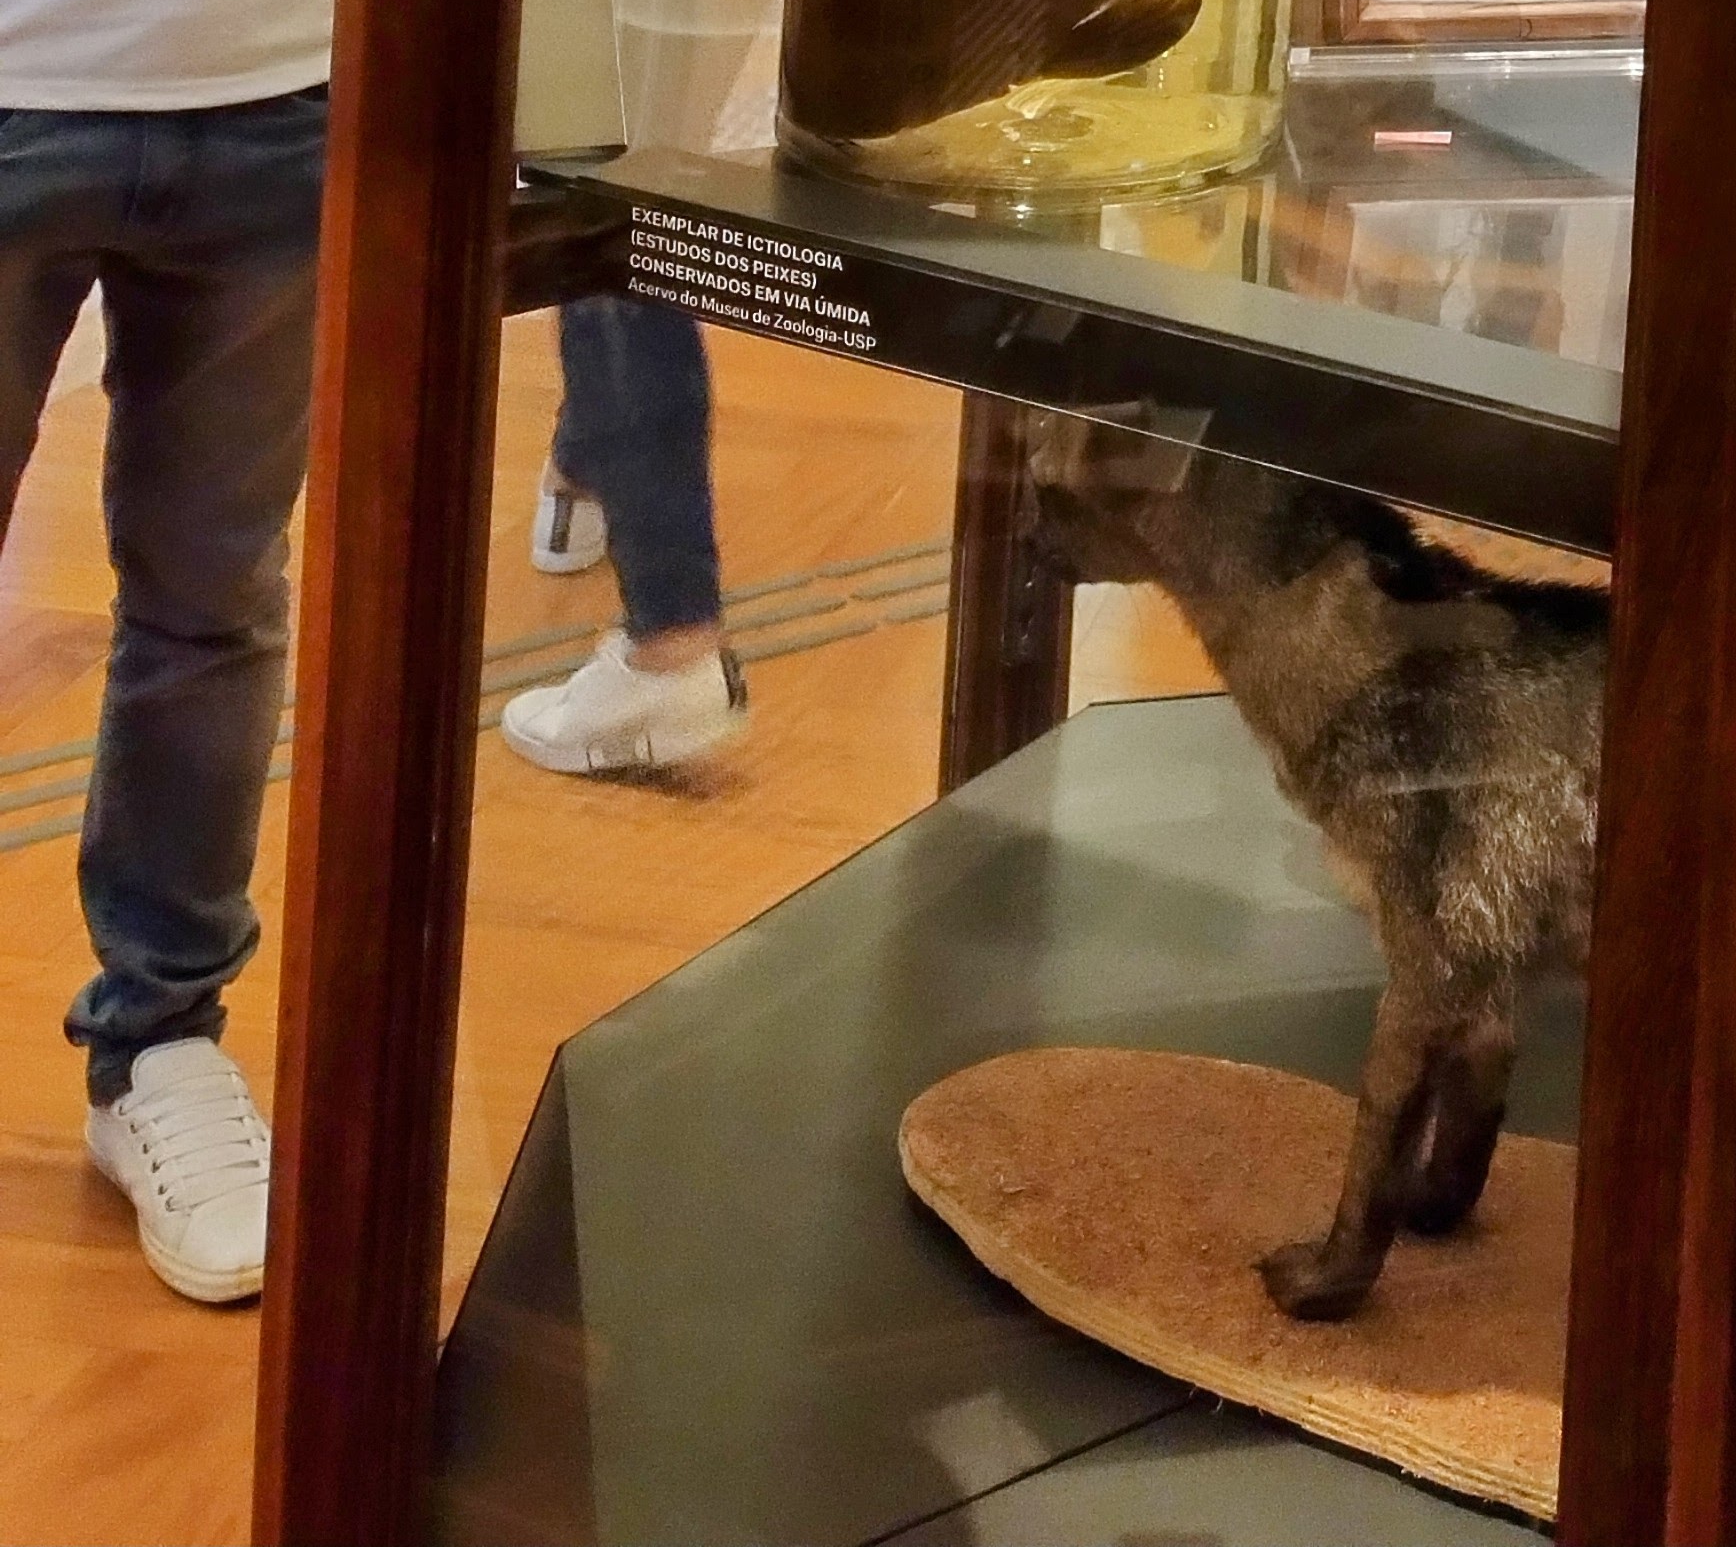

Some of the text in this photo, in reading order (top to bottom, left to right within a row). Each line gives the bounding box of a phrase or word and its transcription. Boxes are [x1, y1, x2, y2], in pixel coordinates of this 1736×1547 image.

[630, 229, 817, 290] (ESTUDOS DOS PEIXES)
[631, 206, 844, 272] EXEMPLAR DE ICTIOLOGIA
[628, 277, 877, 352] Acervo do Museu de Zoologia-USP
[629, 253, 871, 327] CONSERVADOS EM VIA ÚMIDA
